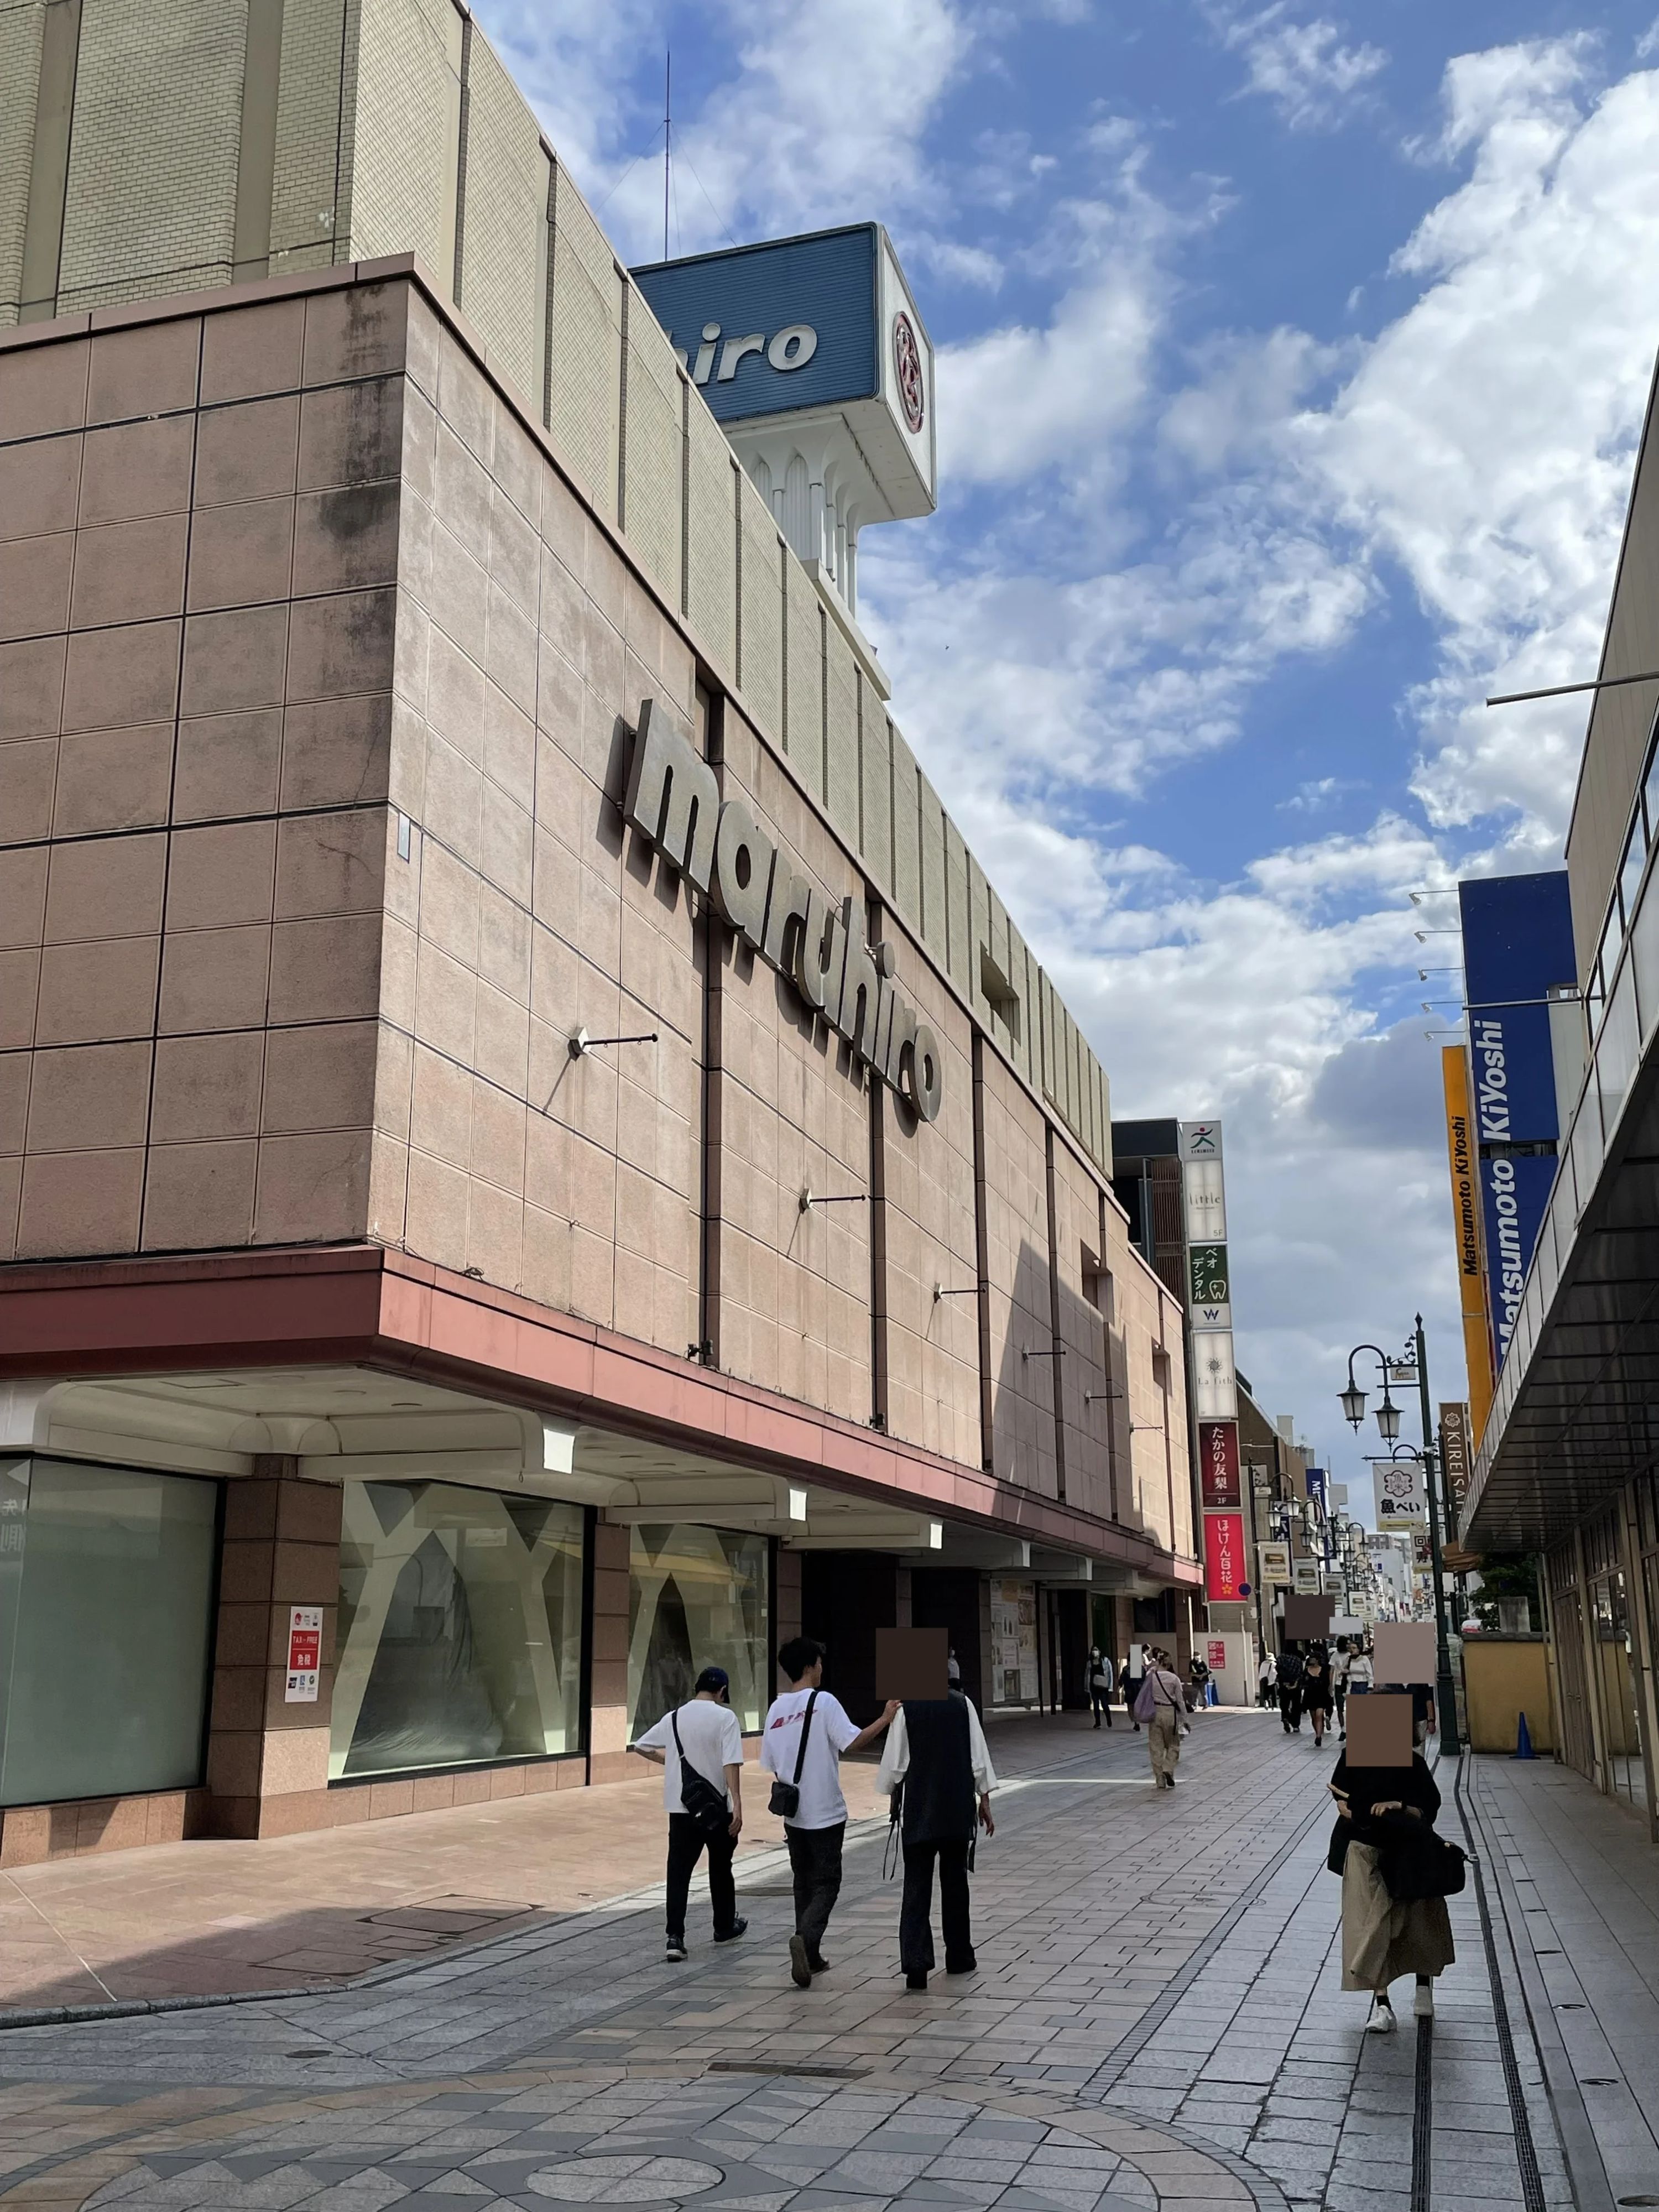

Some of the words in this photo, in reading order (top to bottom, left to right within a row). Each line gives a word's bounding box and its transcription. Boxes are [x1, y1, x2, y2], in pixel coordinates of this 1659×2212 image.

[623, 698, 942, 1122] maruhiro
[1474, 1019, 1511, 1141] KiYoshi
[1451, 1115, 1470, 1176] KiYoshi
[1190, 1192, 1221, 1206] little
[1455, 1180, 1478, 1276] Matsumoto
[1192, 1257, 1206, 1300] デンタル
[1212, 1426, 1228, 1490] たかの友梨
[1217, 1496, 1227, 1505] 2F
[1380, 1499, 1421, 1514] 魚べい
[1217, 1519, 1233, 1584] ほけん百花
